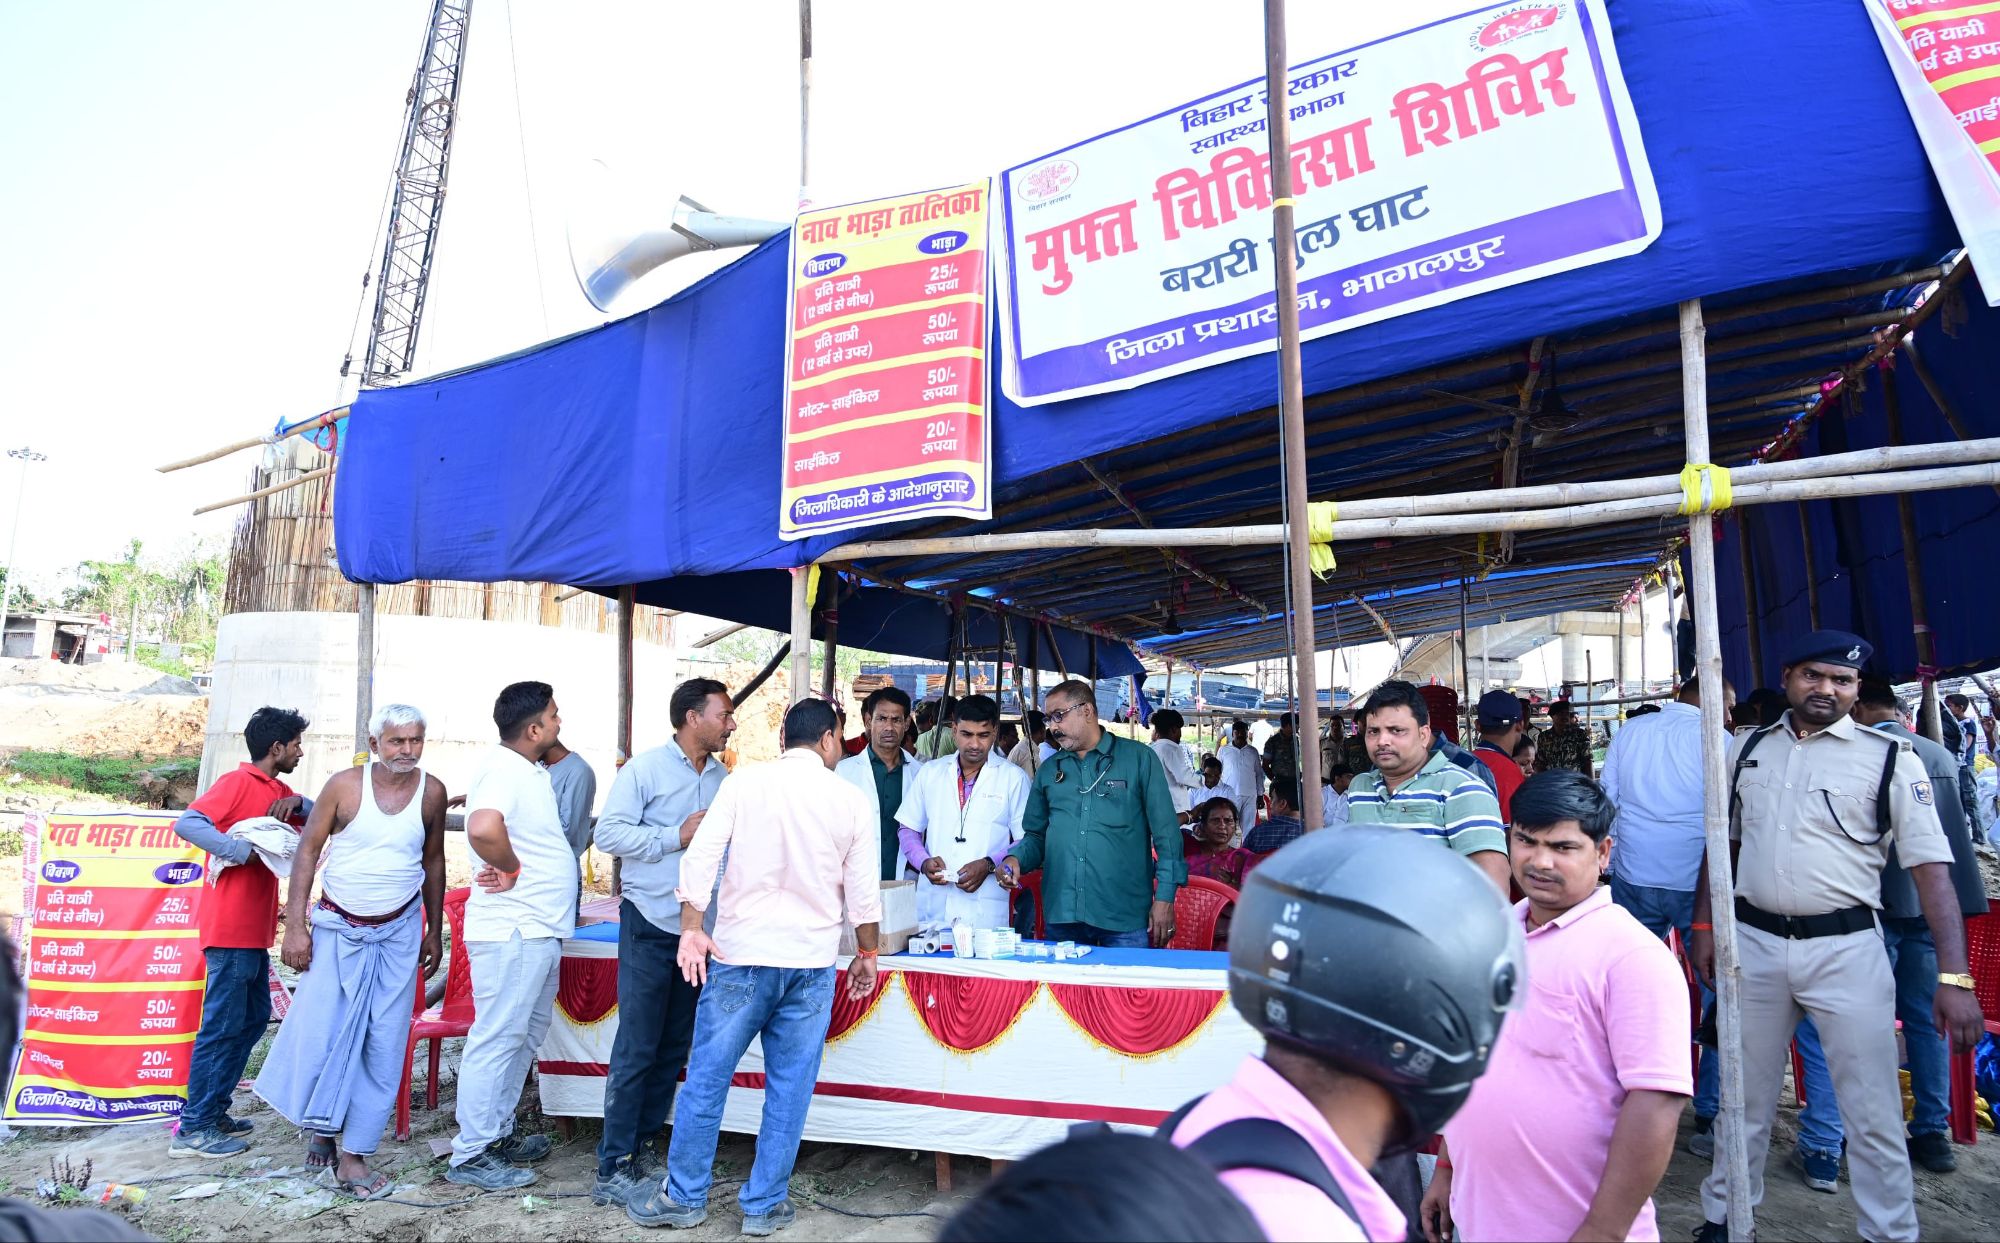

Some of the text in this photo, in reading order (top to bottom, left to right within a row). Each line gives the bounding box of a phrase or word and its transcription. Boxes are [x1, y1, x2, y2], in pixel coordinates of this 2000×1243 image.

[1493, 4, 1542, 19] HEALTH
[1938, 18, 1985, 41] यात्री
[1941, 44, 1964, 65] से
[1965, 41, 2000, 59] उप
[1180, 94, 1254, 133] बिहार
[1189, 118, 1267, 154] स्वास्थ्य
[1024, 198, 1139, 296] मुफ्त
[1389, 46, 1577, 158] शिविर
[801, 188, 983, 244] नाव भाड़ा तालिका
[1159, 237, 1259, 293] बरारी
[1348, 184, 1431, 233] घाट
[807, 235, 957, 276] विवरण भाड़ा
[814, 262, 958, 302] प्रति यात्री 25/-
[834, 295, 845, 311] से
[924, 278, 959, 295] रूपया
[1105, 326, 1186, 366] जिला
[1341, 234, 1507, 299] भागलपुर
[814, 311, 957, 353] प्रति यात्री 50/-
[816, 348, 832, 368] वर्ष
[832, 346, 844, 363] से
[922, 328, 958, 345] रूपया
[927, 366, 956, 385] 50/-
[922, 384, 958, 401] रूपया
[926, 419, 956, 439] 20/-
[921, 438, 958, 455] रूपया
[794, 478, 970, 519] जिलाधिकारी के आदेशानुसार
[86, 823, 139, 854] भाड़ा
[168, 868, 193, 883] भाड़ा
[47, 889, 190, 912] प्रति यात्री 25/-
[46, 907, 63, 922] वर्ष
[63, 908, 75, 923] से
[155, 912, 190, 924] रूपया
[40, 940, 182, 960] प्रति यात्री 50/-
[41, 959, 57, 974] वर्ष
[57, 960, 68, 975] से
[146, 962, 182, 975] रूपया
[146, 999, 176, 1015] 50/-
[140, 1017, 176, 1029] रूपया
[142, 1050, 172, 1066] 20/-
[137, 1068, 173, 1079] रूपया
